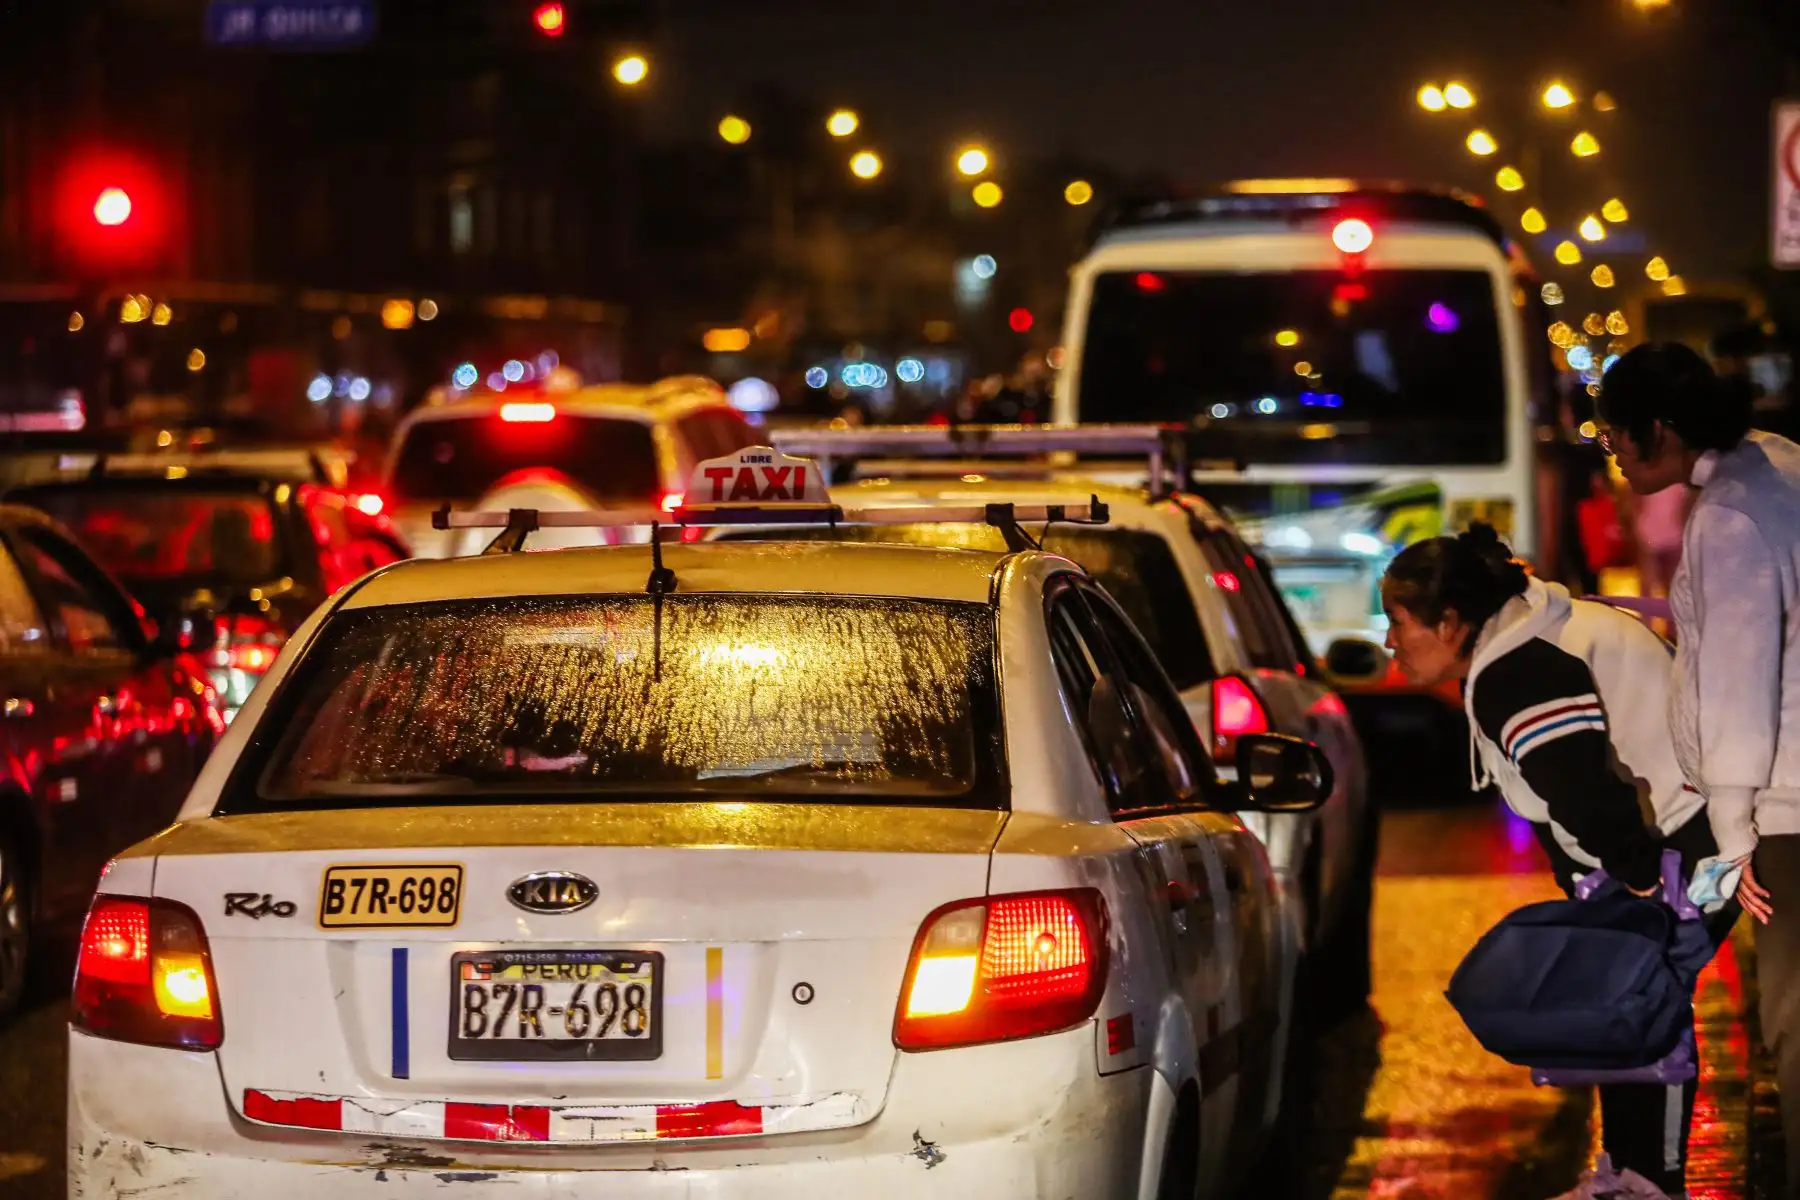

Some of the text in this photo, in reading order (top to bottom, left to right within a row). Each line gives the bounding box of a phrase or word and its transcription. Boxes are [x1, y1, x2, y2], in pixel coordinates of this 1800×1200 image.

[740, 455, 772, 463] LIBRE
[704, 466, 806, 500] TAXI
[325, 876, 456, 914] B7R-698
[524, 879, 582, 903] KIA
[224, 892, 298, 920] Rio
[522, 964, 592, 980] PERU
[462, 982, 648, 1038] B7R-698
